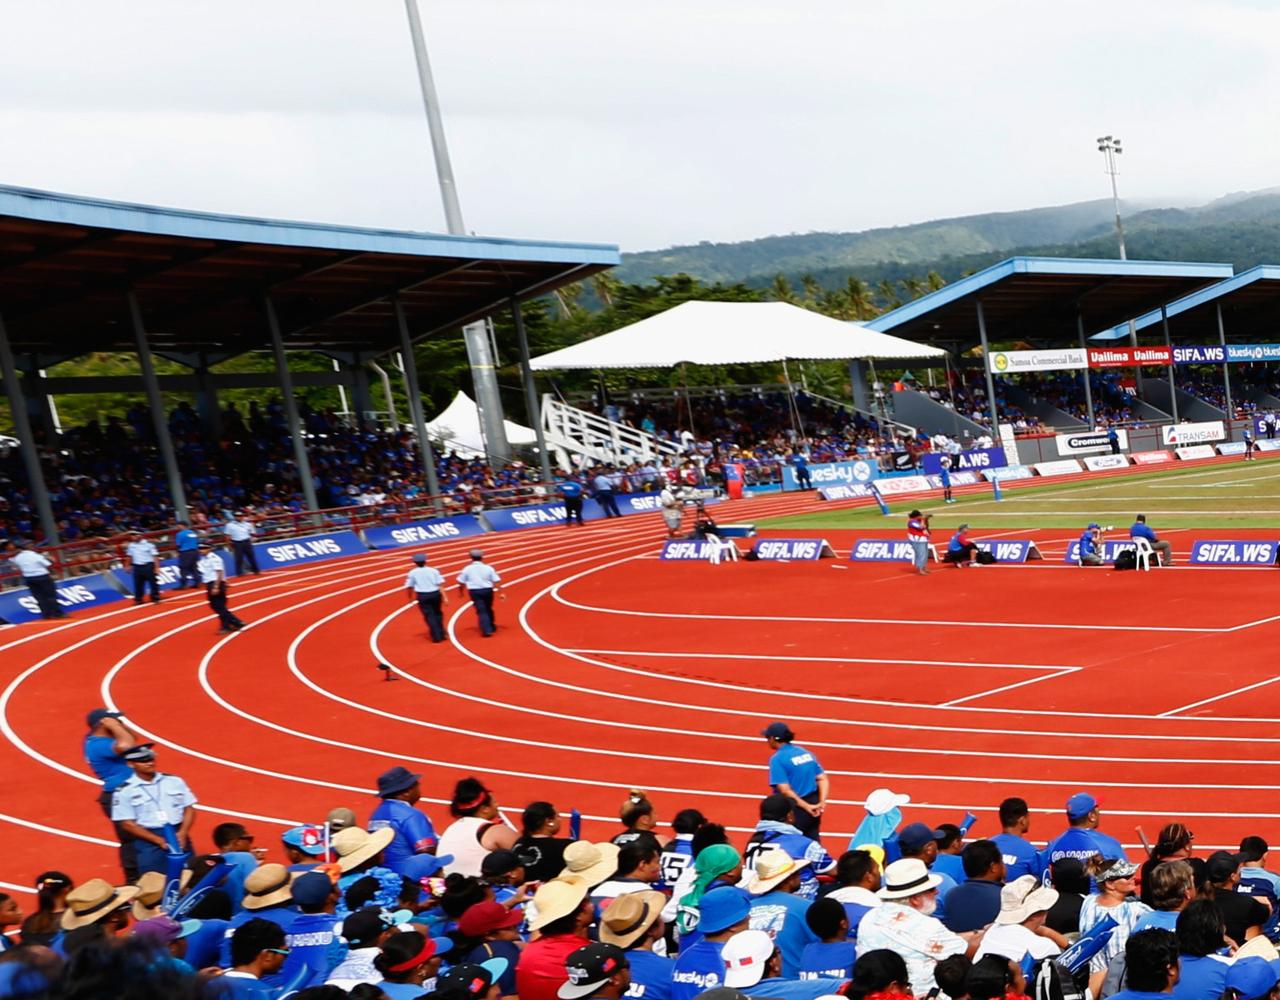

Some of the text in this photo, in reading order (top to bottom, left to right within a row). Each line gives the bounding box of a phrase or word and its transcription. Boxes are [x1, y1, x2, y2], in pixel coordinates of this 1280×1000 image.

[1173, 348, 1224, 361] SIFA.WS
[1178, 430, 1219, 440] TRANSAM
[391, 522, 460, 544] SIFA.WS
[267, 538, 342, 563] SIFA.WS
[756, 541, 818, 559] SIFA.WS
[1197, 544, 1272, 562] SIFA.WS
